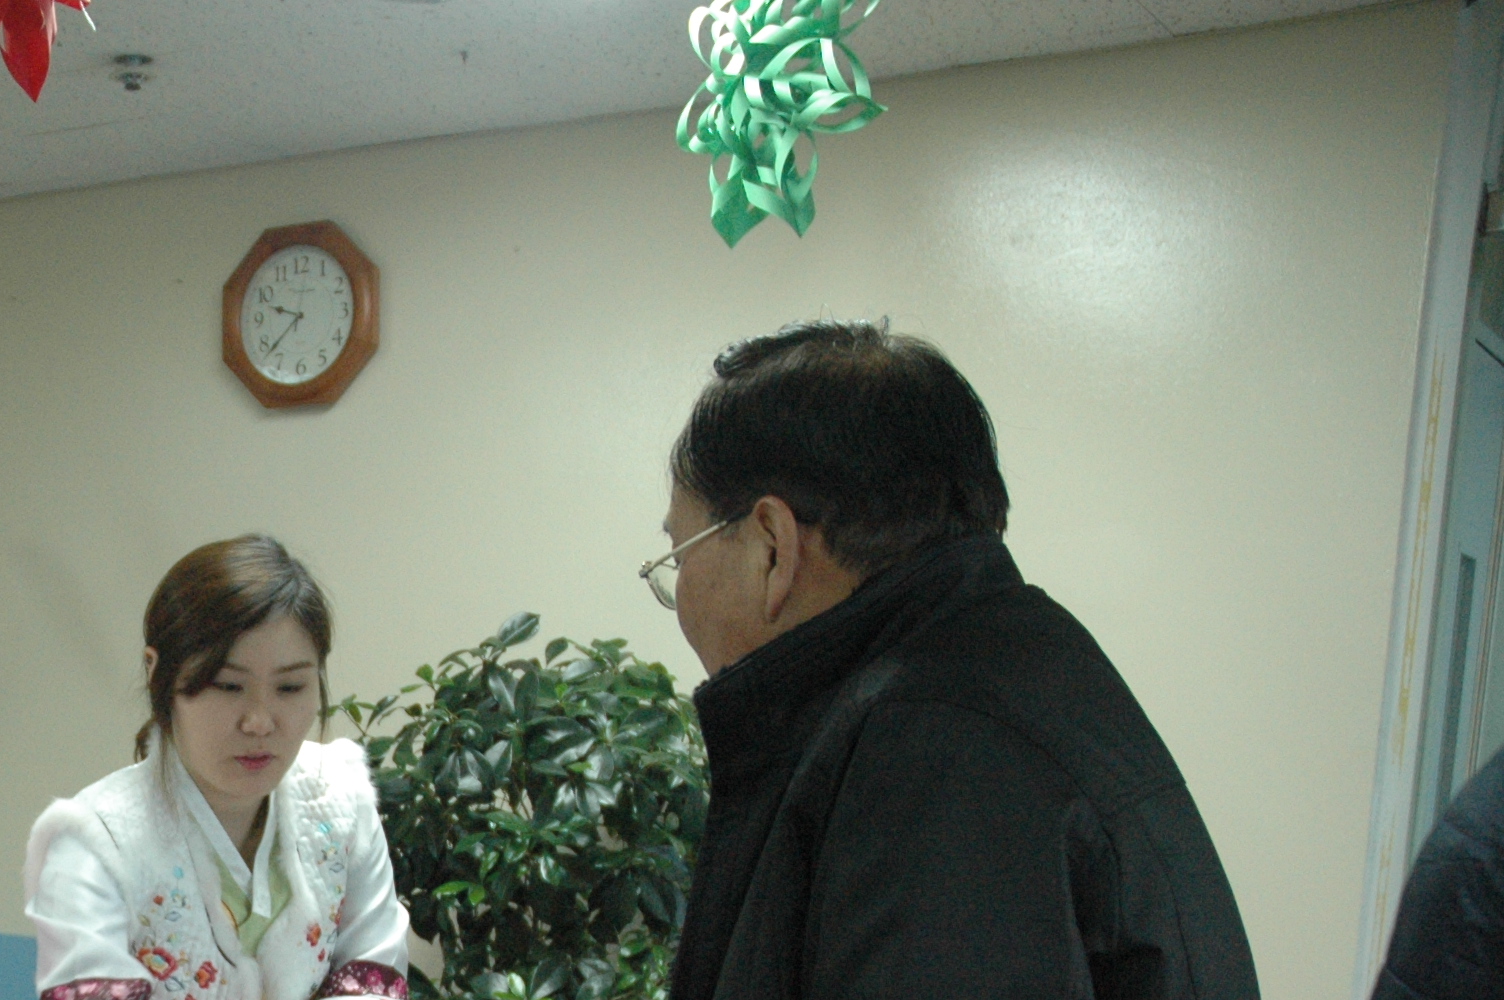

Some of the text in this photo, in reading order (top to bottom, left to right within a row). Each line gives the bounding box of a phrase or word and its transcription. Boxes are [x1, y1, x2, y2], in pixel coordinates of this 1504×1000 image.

[276, 265, 287, 282] 11
[293, 255, 310, 275] 12
[259, 285, 274, 303] 10
[334, 276, 344, 294] 2
[338, 301, 349, 319] 3
[254, 311, 264, 328] 9
[259, 334, 270, 352] 8
[331, 327, 343, 346] 4
[274, 352, 284, 371] 7
[295, 357, 307, 375] 6
[317, 348, 327, 367] 5
